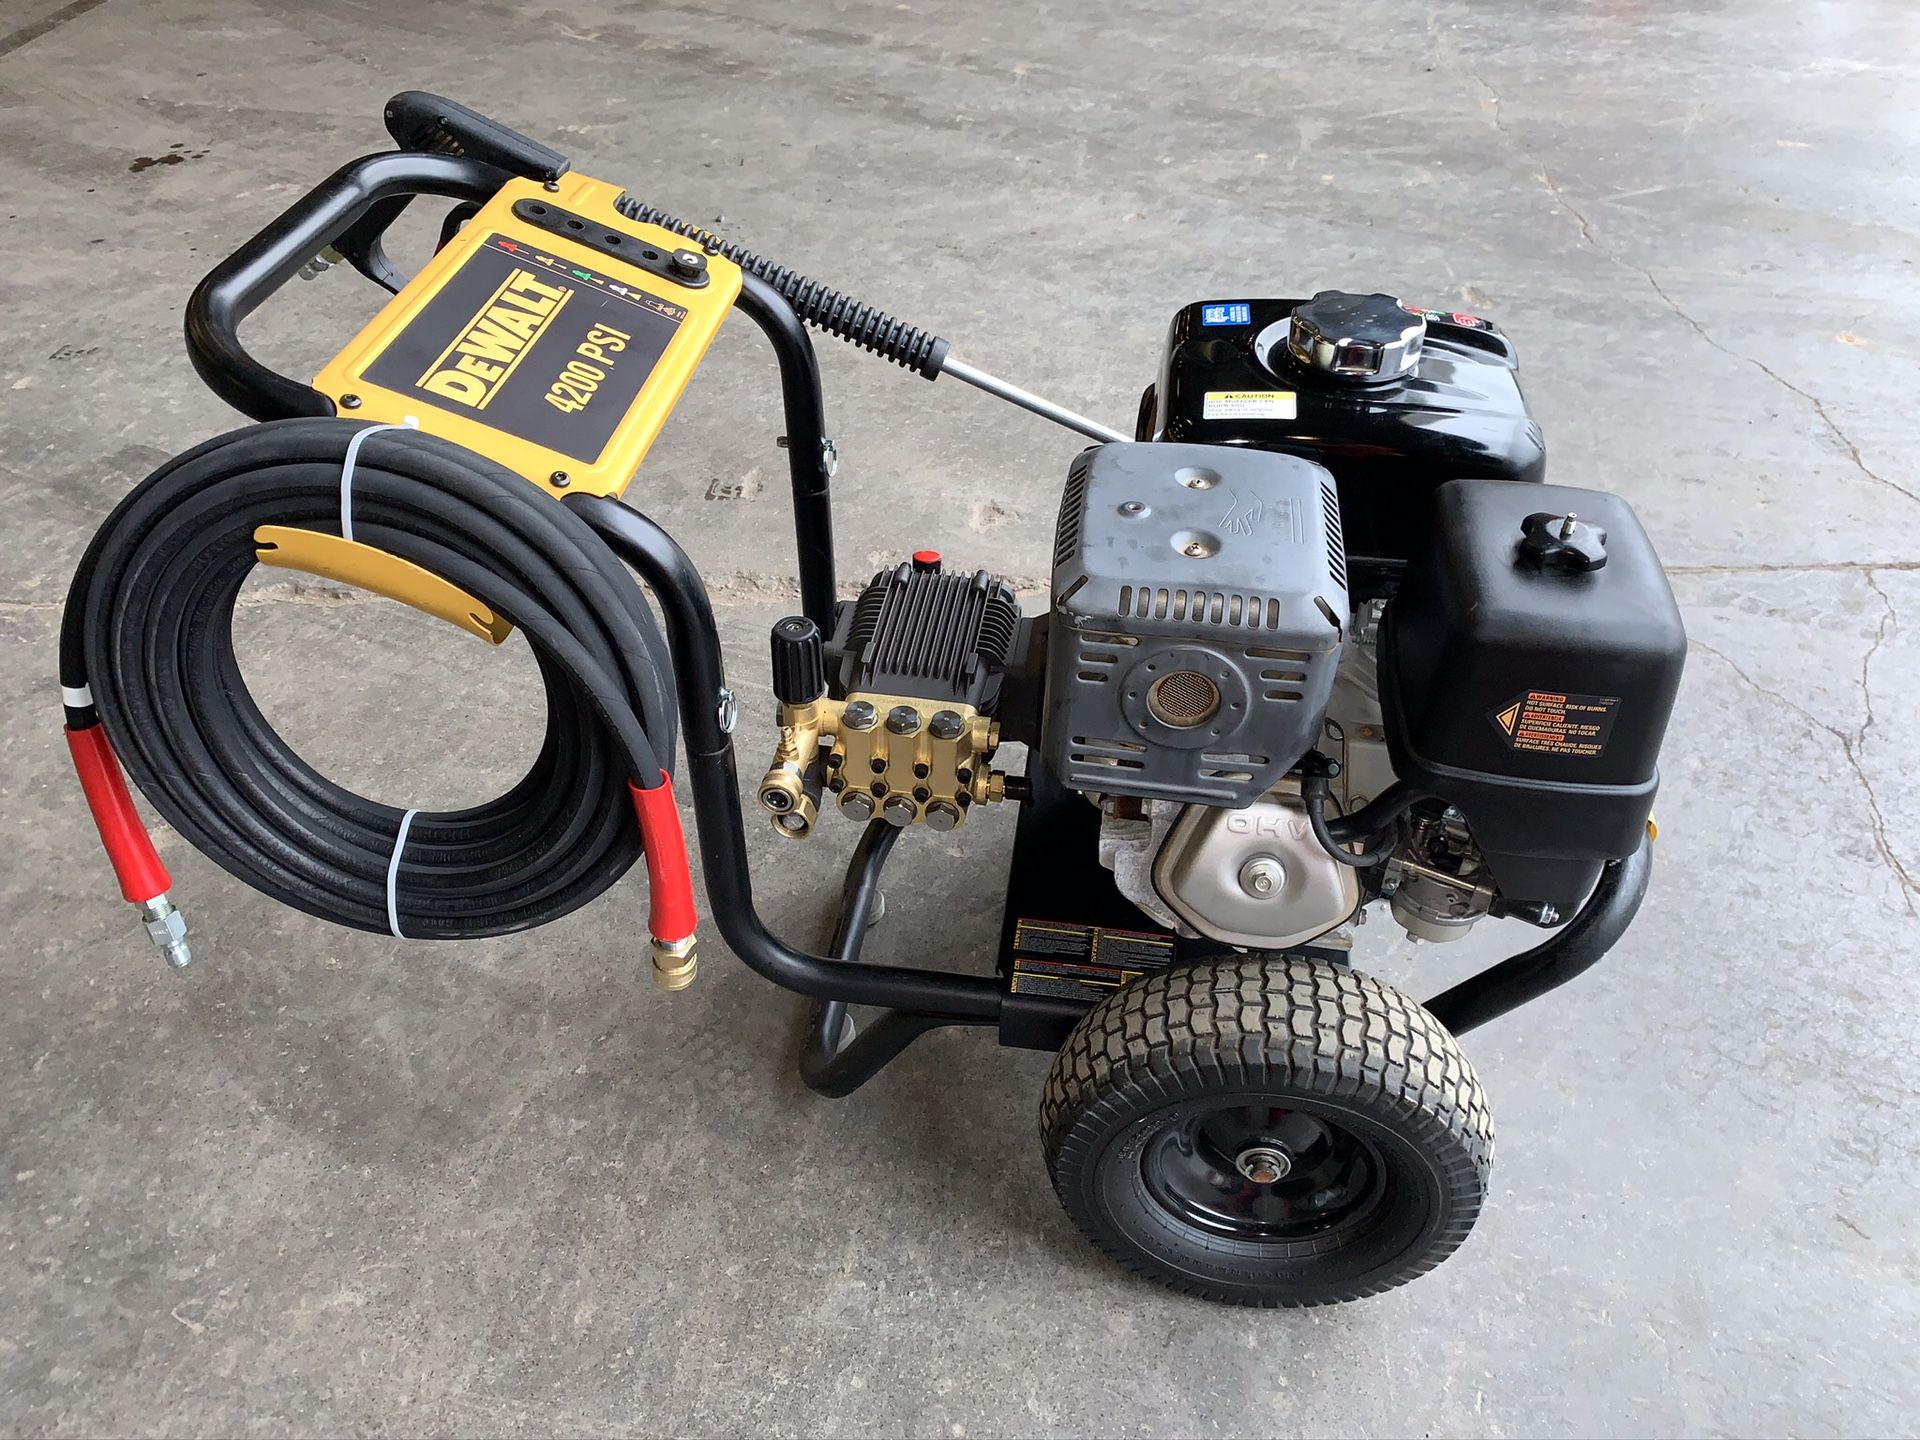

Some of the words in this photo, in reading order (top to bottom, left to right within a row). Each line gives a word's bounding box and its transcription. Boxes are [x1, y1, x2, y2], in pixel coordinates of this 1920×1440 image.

[423, 270, 567, 408] DEWALT
[544, 360, 606, 414] 4200
[576, 322, 632, 367] PSI
[1536, 694, 1564, 702] WARNING
[1539, 701, 1564, 709] SURFACE.
[1547, 707, 1566, 715] TOUCH.
[1521, 719, 1552, 727] SUPERFICIE
[1552, 722, 1579, 730] CALIENTE.
[1525, 732, 1563, 740] AVERTISSEMENT
[1528, 725, 1567, 734] QUEMADURAS.
[1578, 729, 1597, 737] TOCAR.
[1515, 737, 1540, 745] SURFACE
[1554, 741, 1578, 749] CHAUDE.
[1559, 746, 1571, 754] PAS
[1571, 748, 1597, 756] TOUCHER.
[1227, 814, 1309, 841] OHV
